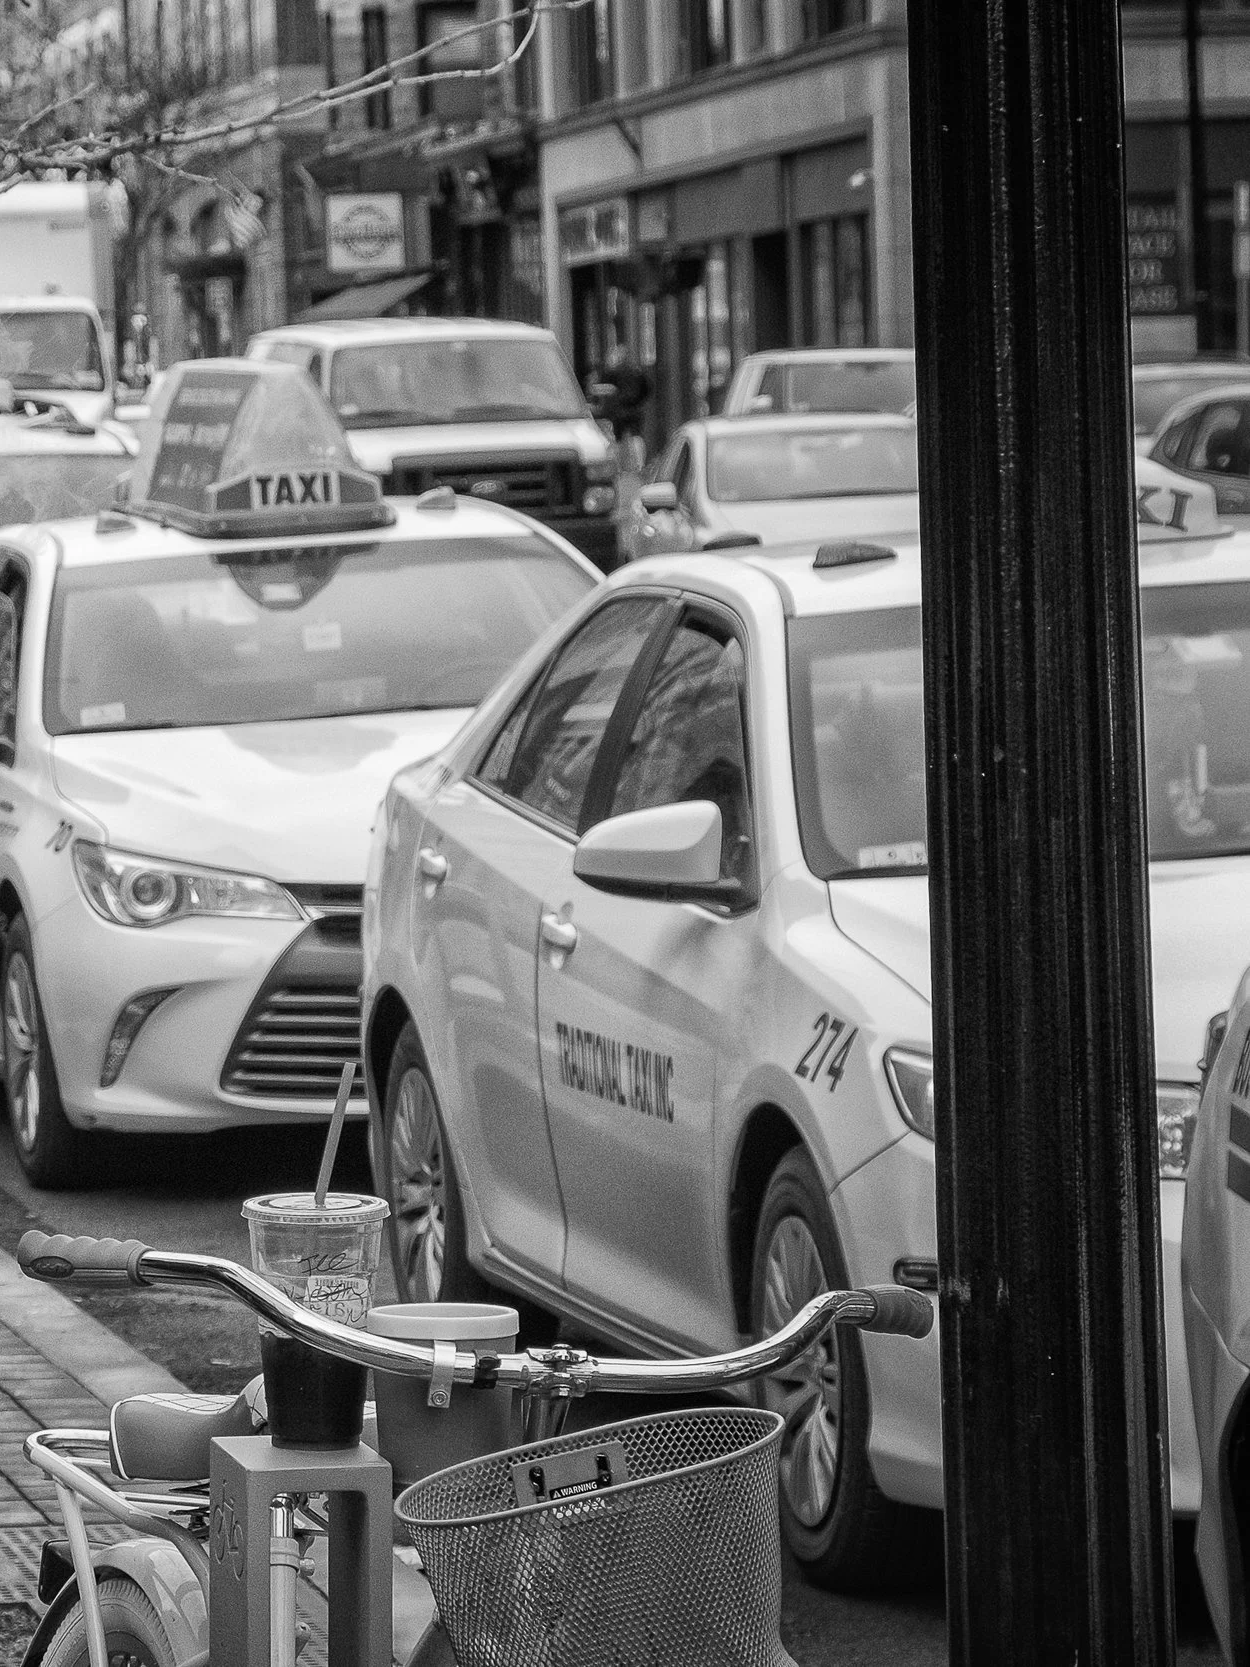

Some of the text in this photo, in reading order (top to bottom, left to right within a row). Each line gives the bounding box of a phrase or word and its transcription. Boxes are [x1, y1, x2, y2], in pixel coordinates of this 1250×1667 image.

[256, 472, 332, 506] TAXI
[555, 1021, 626, 1107] TRADITIONAL
[795, 1011, 859, 1092] 274
[560, 1481, 598, 1497] WARNING
